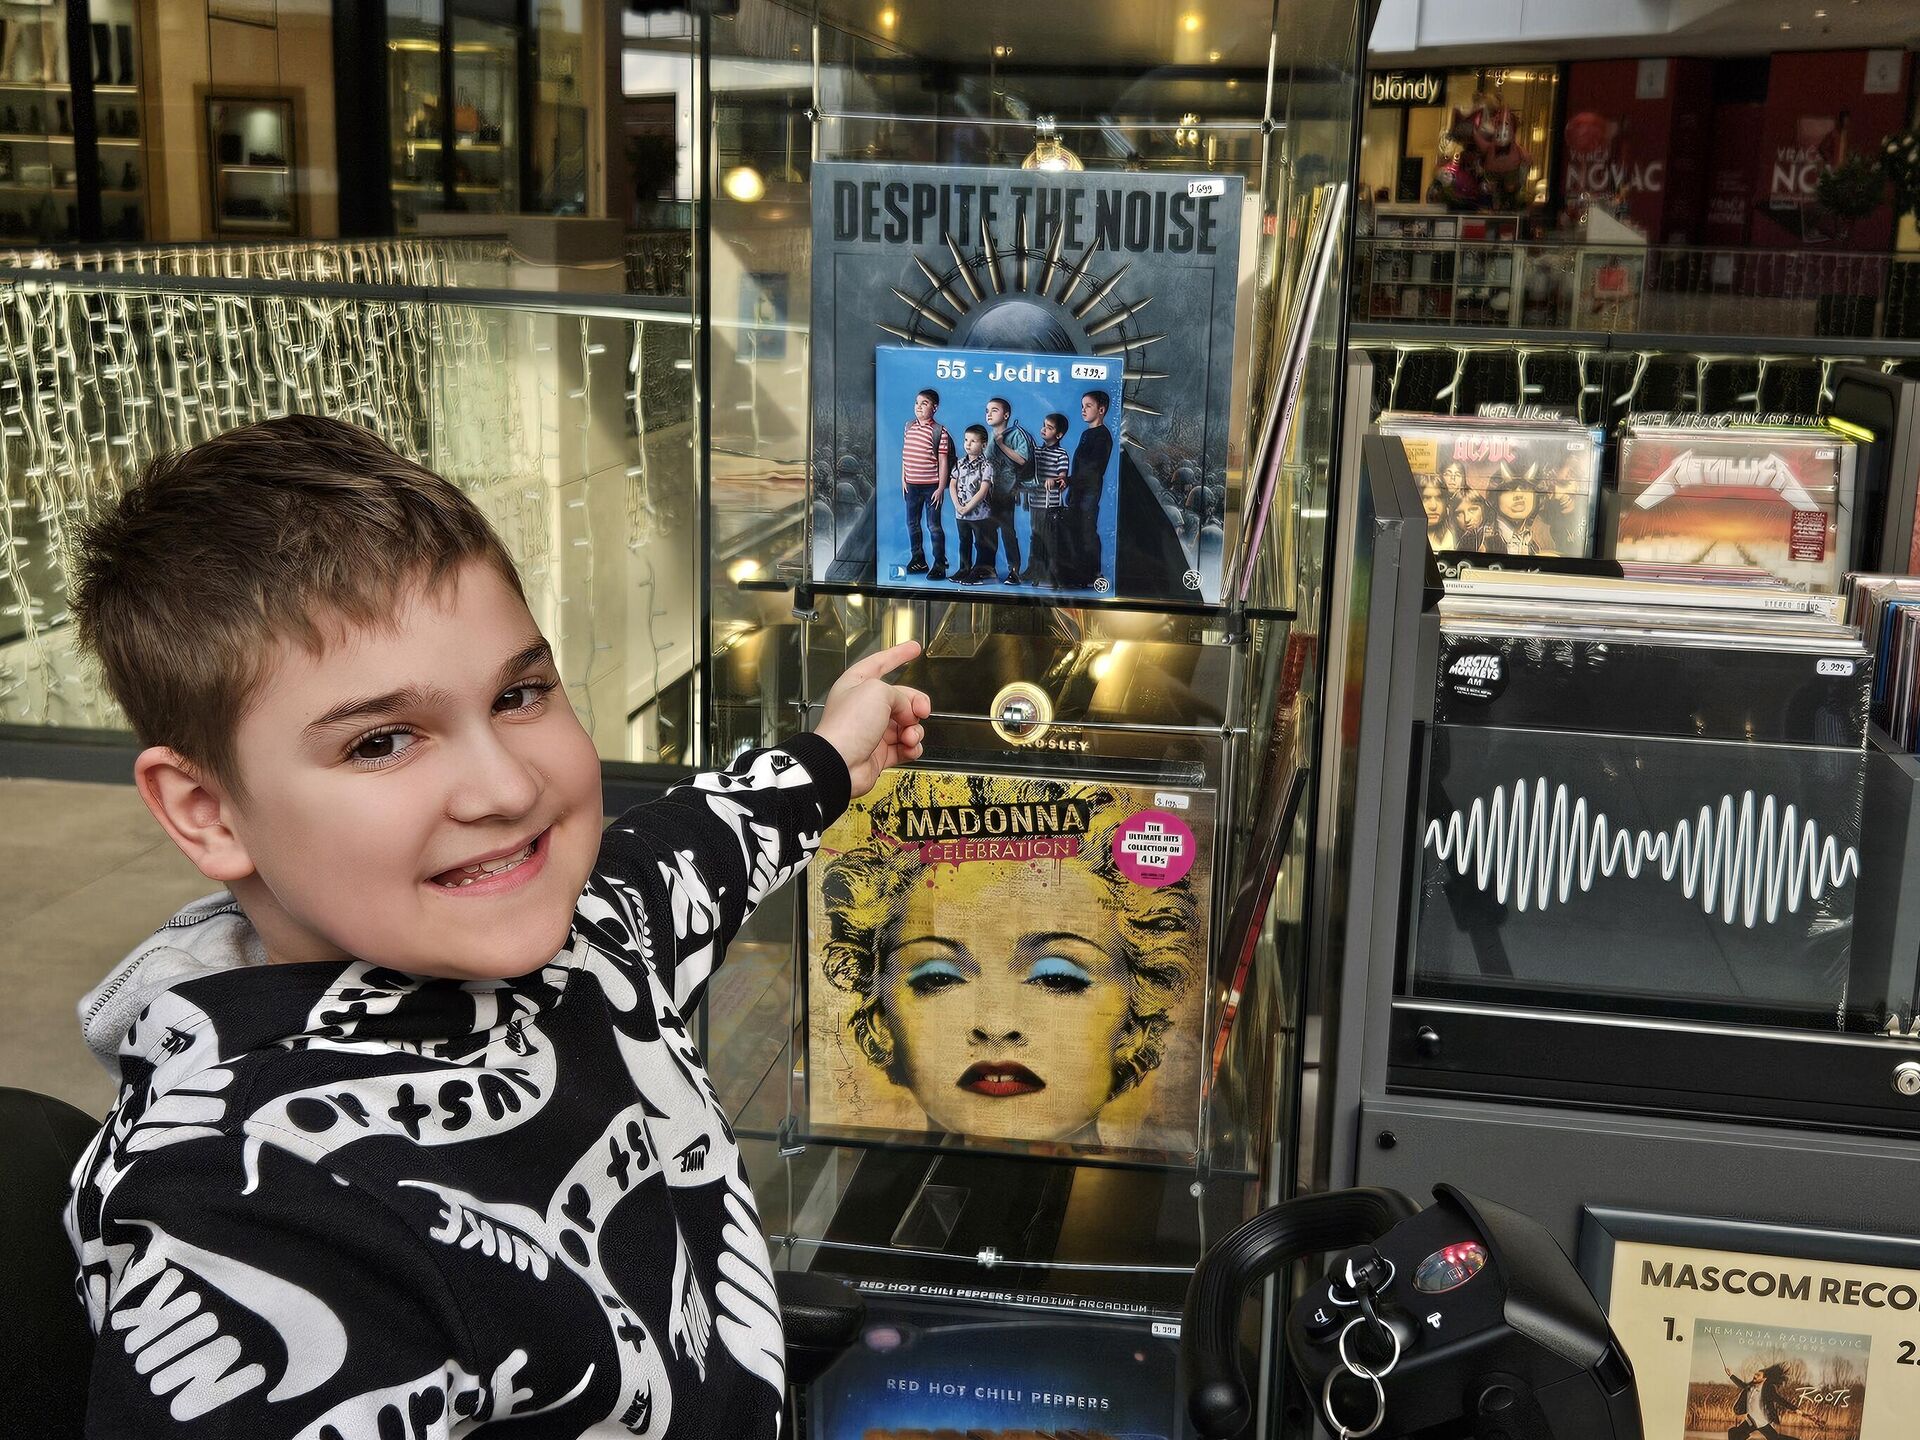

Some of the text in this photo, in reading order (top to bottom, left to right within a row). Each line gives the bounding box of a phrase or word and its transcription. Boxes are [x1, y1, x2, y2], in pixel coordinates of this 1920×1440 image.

[1565, 161, 1664, 193] NOVAC
[833, 179, 1219, 255] DESPITE THE NOISE
[935, 359, 967, 380] 55
[988, 362, 1060, 384] Jedra
[1634, 448, 1821, 511] METALLICA
[1449, 664, 1500, 680] MONKEYS
[1455, 655, 1500, 669] ARCTIC
[1467, 677, 1483, 686] AM
[906, 803, 1086, 838] MADONNA
[1147, 824, 1161, 832] THE
[1127, 843, 1168, 853] COLLECTION
[1128, 833, 1179, 843] ULTIMATE HITS
[928, 839, 1071, 861] CELEBRATION
[1141, 855, 1165, 864] 4 LPs
[429, 1200, 549, 1282] NIKE
[859, 1280, 1148, 1313] RED HOT CHILI PEPPERS STADIUM ARCADIUM
[1640, 1259, 1920, 1313] MASCOM RECO
[1663, 1316, 1684, 1343] 1.
[1703, 1325, 1771, 1340] NEMANJA
[1738, 1338, 1787, 1349] DOUBLE
[886, 1377, 1110, 1410] RED HOT CHILI PEPPERS
